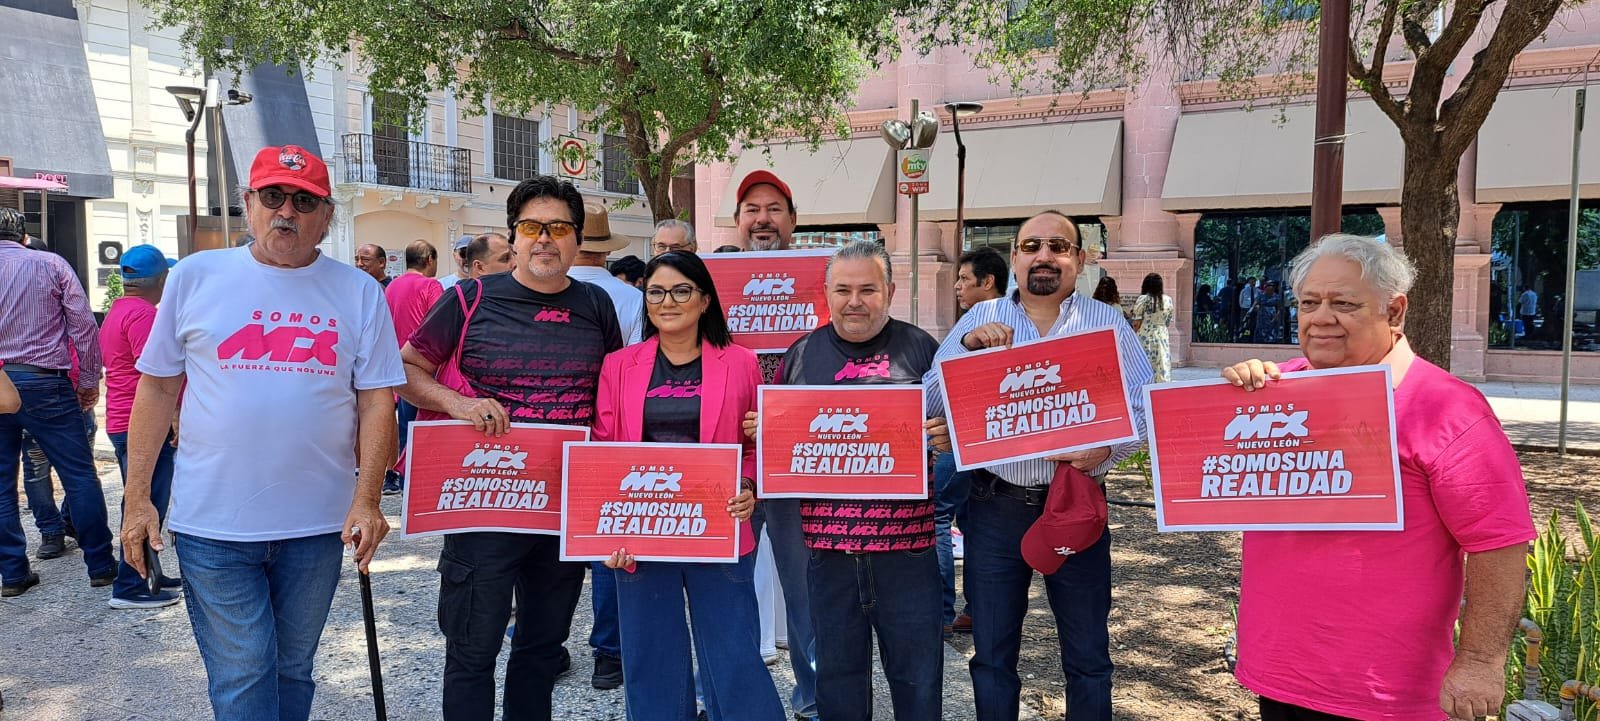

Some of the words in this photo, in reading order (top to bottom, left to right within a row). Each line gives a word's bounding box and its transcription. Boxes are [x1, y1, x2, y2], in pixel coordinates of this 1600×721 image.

[907, 162, 926, 171] mty
[728, 303, 814, 317] #SOMOSUNA
[252, 310, 336, 328] SOMOS
[727, 315, 818, 332] REALIDAD
[217, 324, 338, 366] MX
[1006, 360, 1050, 373] SOMOS
[1010, 391, 1034, 399] NUEVO
[1036, 385, 1056, 394] LEÓN
[985, 389, 1089, 421] #SOMOSUNA
[1235, 403, 1294, 414] SOMOS
[986, 403, 1096, 440] REALIDAD
[792, 443, 890, 456] #SOMOSUNA
[1237, 441, 1271, 449] NUEVO
[1273, 439, 1300, 447] LEÓN
[790, 457, 895, 474] REALIDAD
[1202, 450, 1345, 474] #SOMOSUNA
[497, 468, 518, 476] LEÓN
[441, 478, 546, 493] #SOMOSUNA
[1201, 470, 1353, 498] REALIDAD
[437, 491, 549, 510] REALIDAD
[655, 491, 674, 499] LEÓN
[600, 501, 703, 517] #SOMOSUNA
[596, 516, 707, 536] REALIDAD
